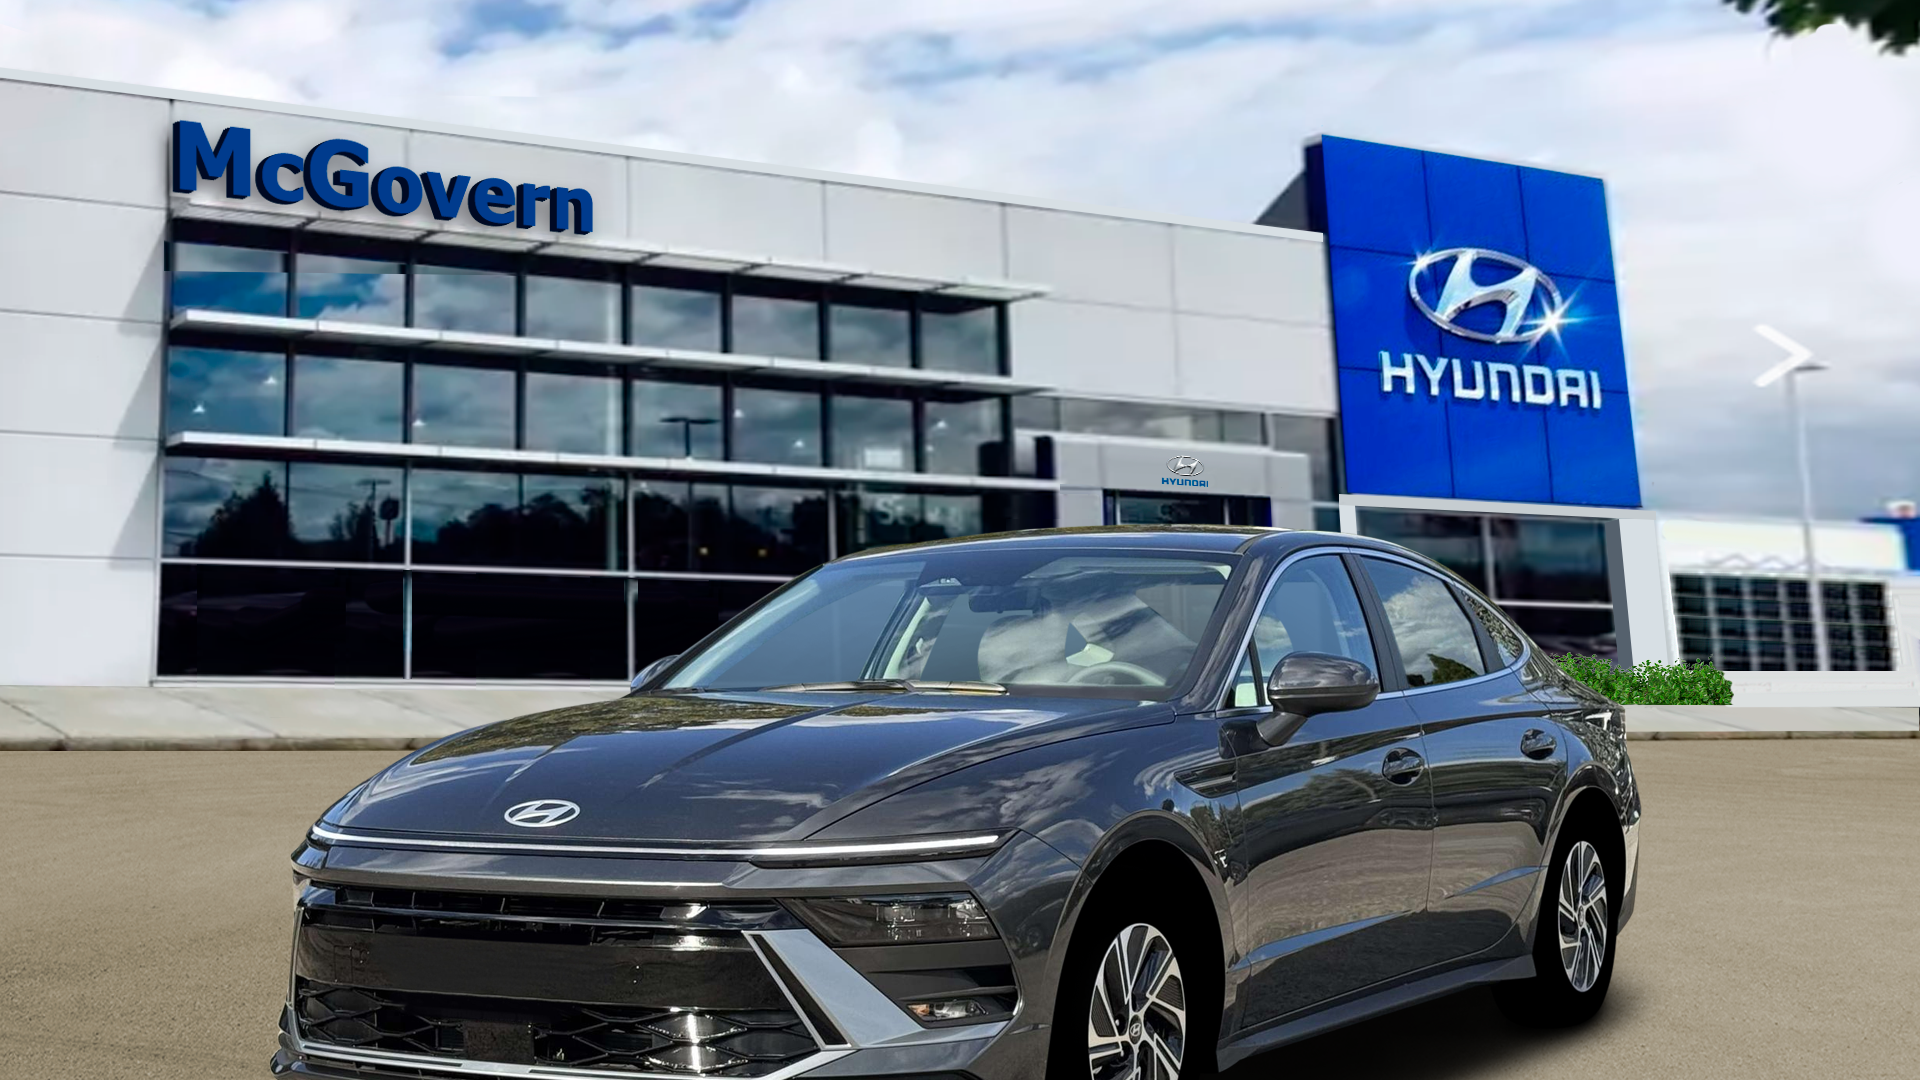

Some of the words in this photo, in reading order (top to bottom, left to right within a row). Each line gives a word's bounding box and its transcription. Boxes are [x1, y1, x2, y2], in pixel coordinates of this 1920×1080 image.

[172, 120, 594, 235] McGovern
[1379, 350, 1602, 409] HYUNDAI
[1161, 477, 1209, 488] HYUNDAI
